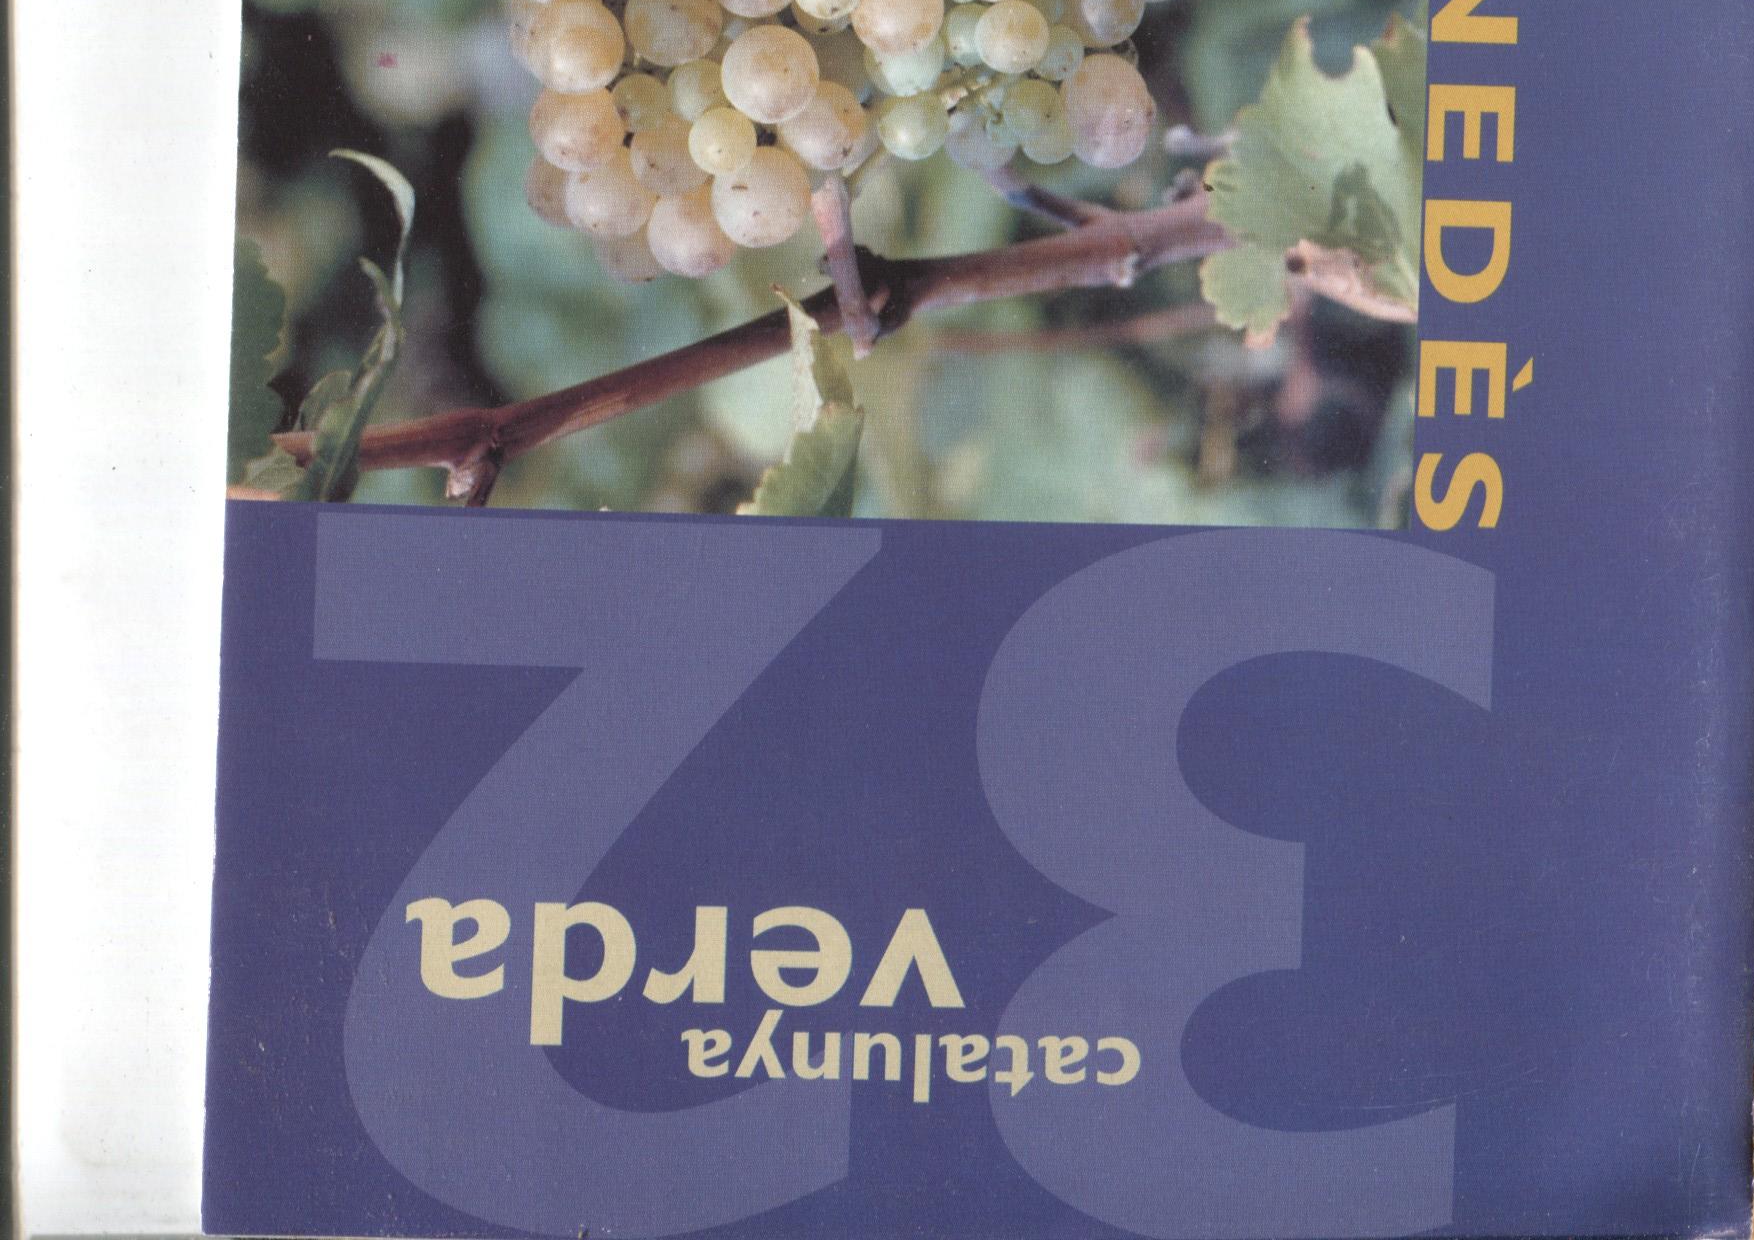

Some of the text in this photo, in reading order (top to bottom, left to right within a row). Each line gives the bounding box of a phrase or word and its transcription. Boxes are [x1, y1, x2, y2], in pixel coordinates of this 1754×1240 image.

[312, 511, 1496, 1240] 32
[404, 896, 965, 1046] verda
[680, 1009, 1142, 1102] catalunya
